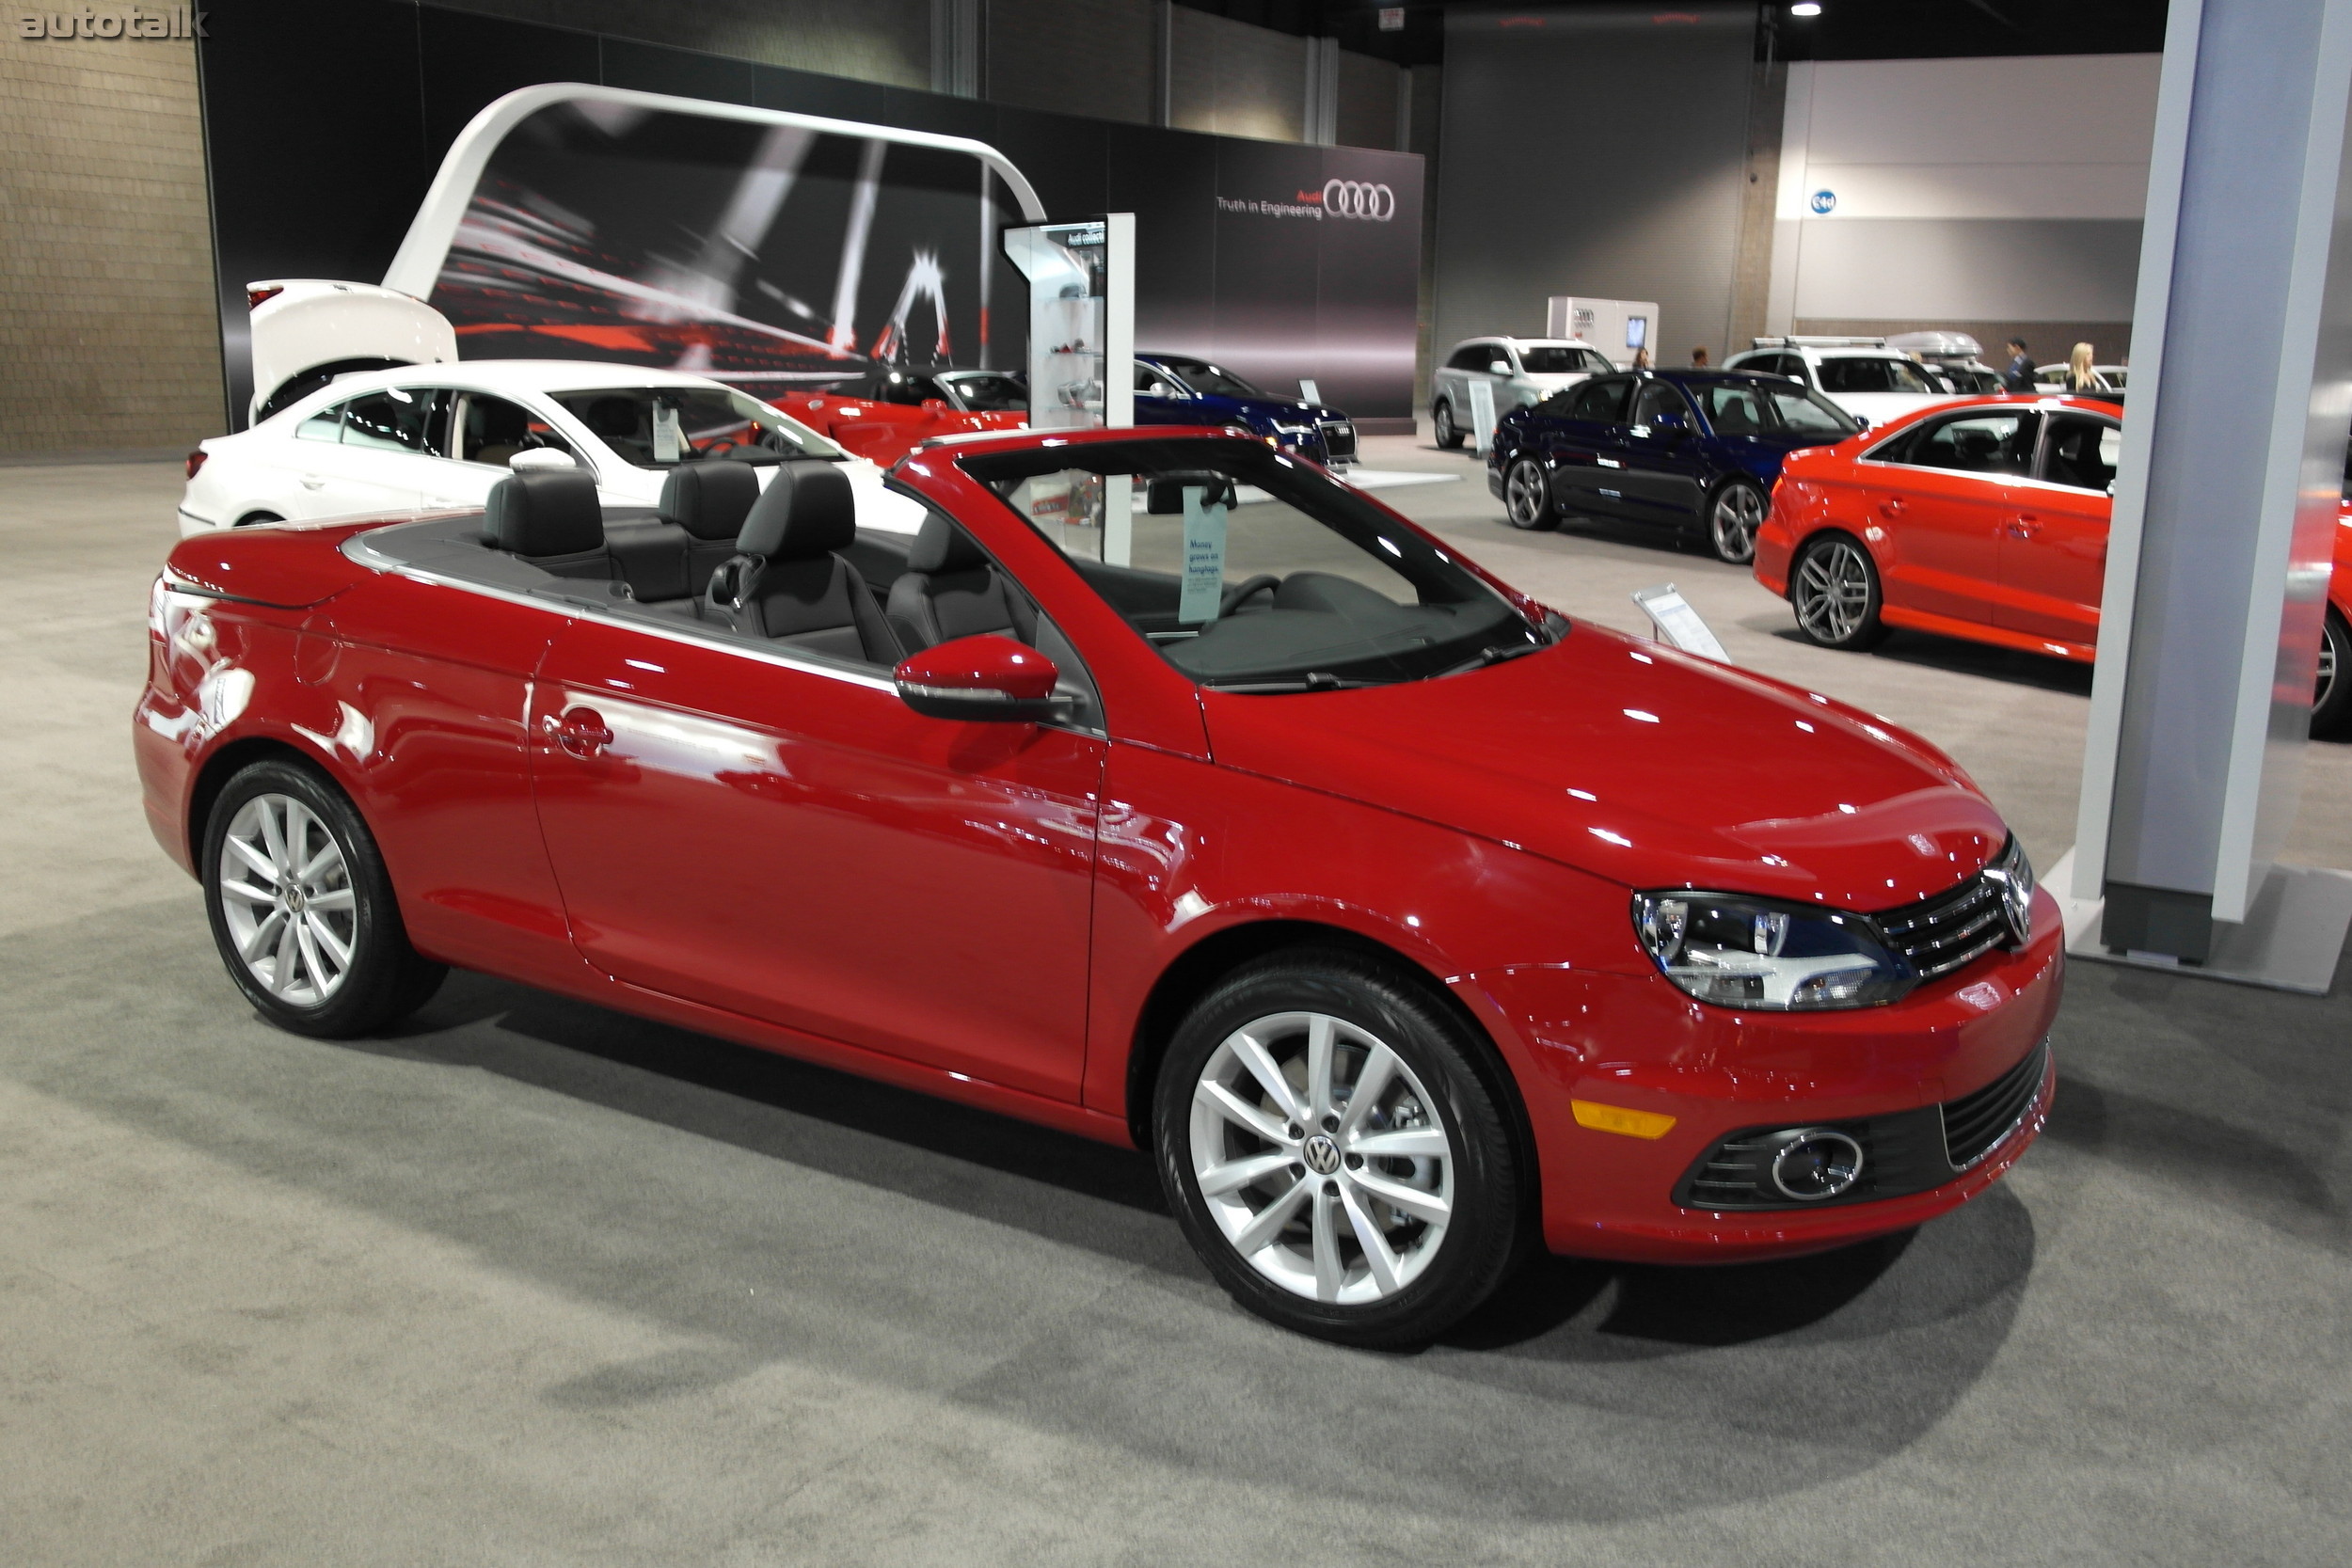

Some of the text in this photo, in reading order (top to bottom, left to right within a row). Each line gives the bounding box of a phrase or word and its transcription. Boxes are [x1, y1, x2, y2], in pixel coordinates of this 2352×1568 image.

[1296, 190, 1322, 203] Audi
[1216, 197, 1322, 221] Truth in Engineering
[1068, 232, 1082, 245] Audi
[1189, 539, 1213, 550] Money
[1189, 553, 1209, 563] grows
